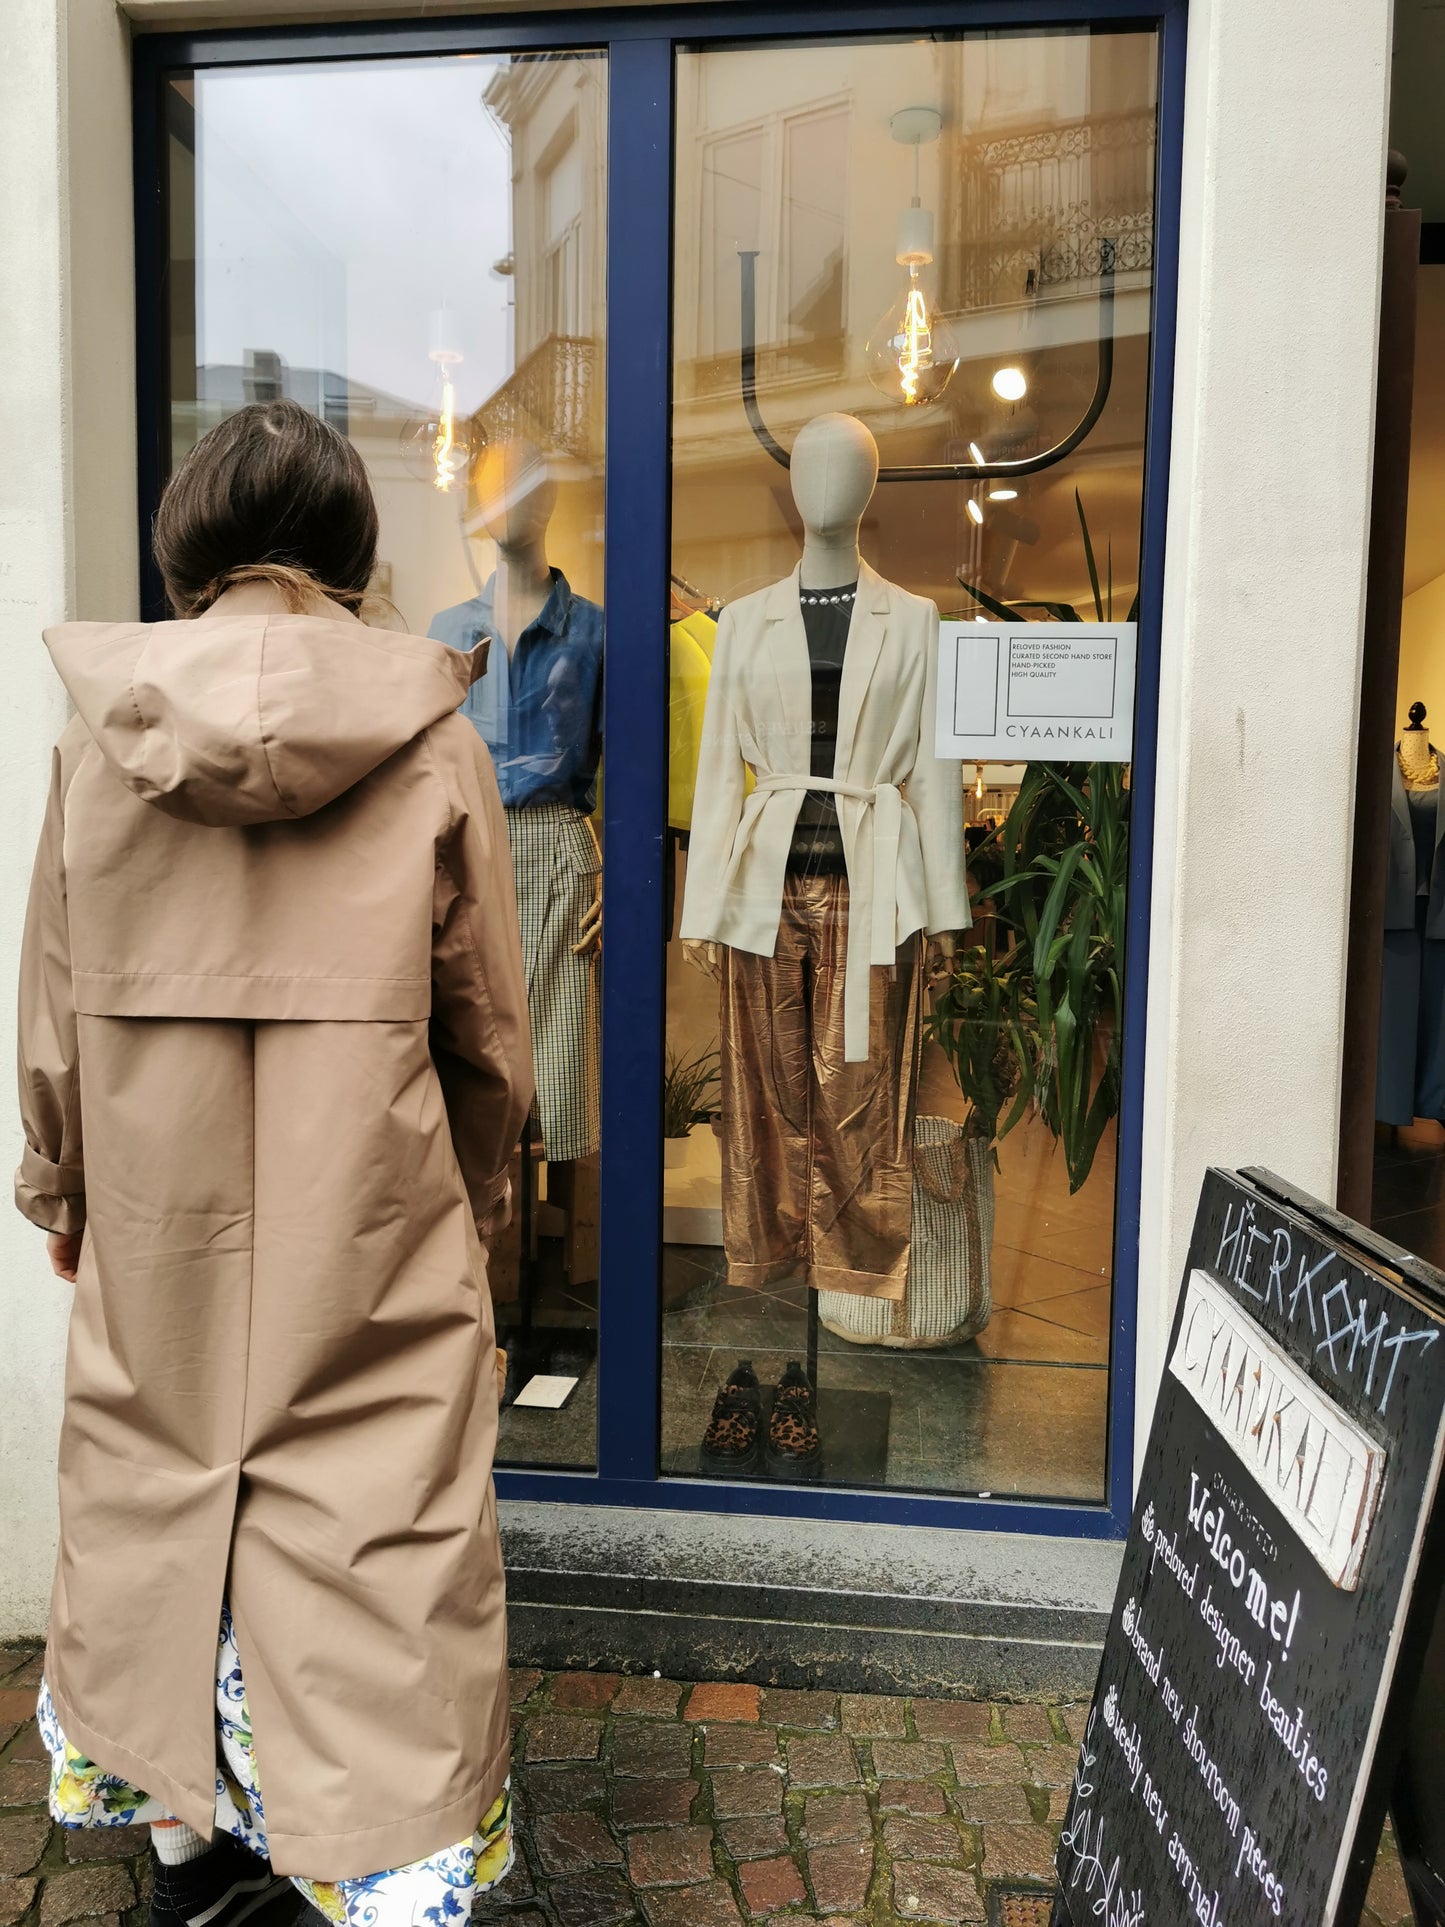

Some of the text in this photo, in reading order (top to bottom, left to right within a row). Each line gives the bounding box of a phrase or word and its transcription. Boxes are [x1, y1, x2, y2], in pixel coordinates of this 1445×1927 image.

[1006, 725, 1113, 739] CYAANKALI
[1150, 1529, 1328, 1801] preloved designer beauties
[1188, 1471, 1301, 1662] Welcome!
[1114, 1709, 1223, 1927] weekly new arrival
[1131, 1607, 1283, 1916] brand new showroom pieces
